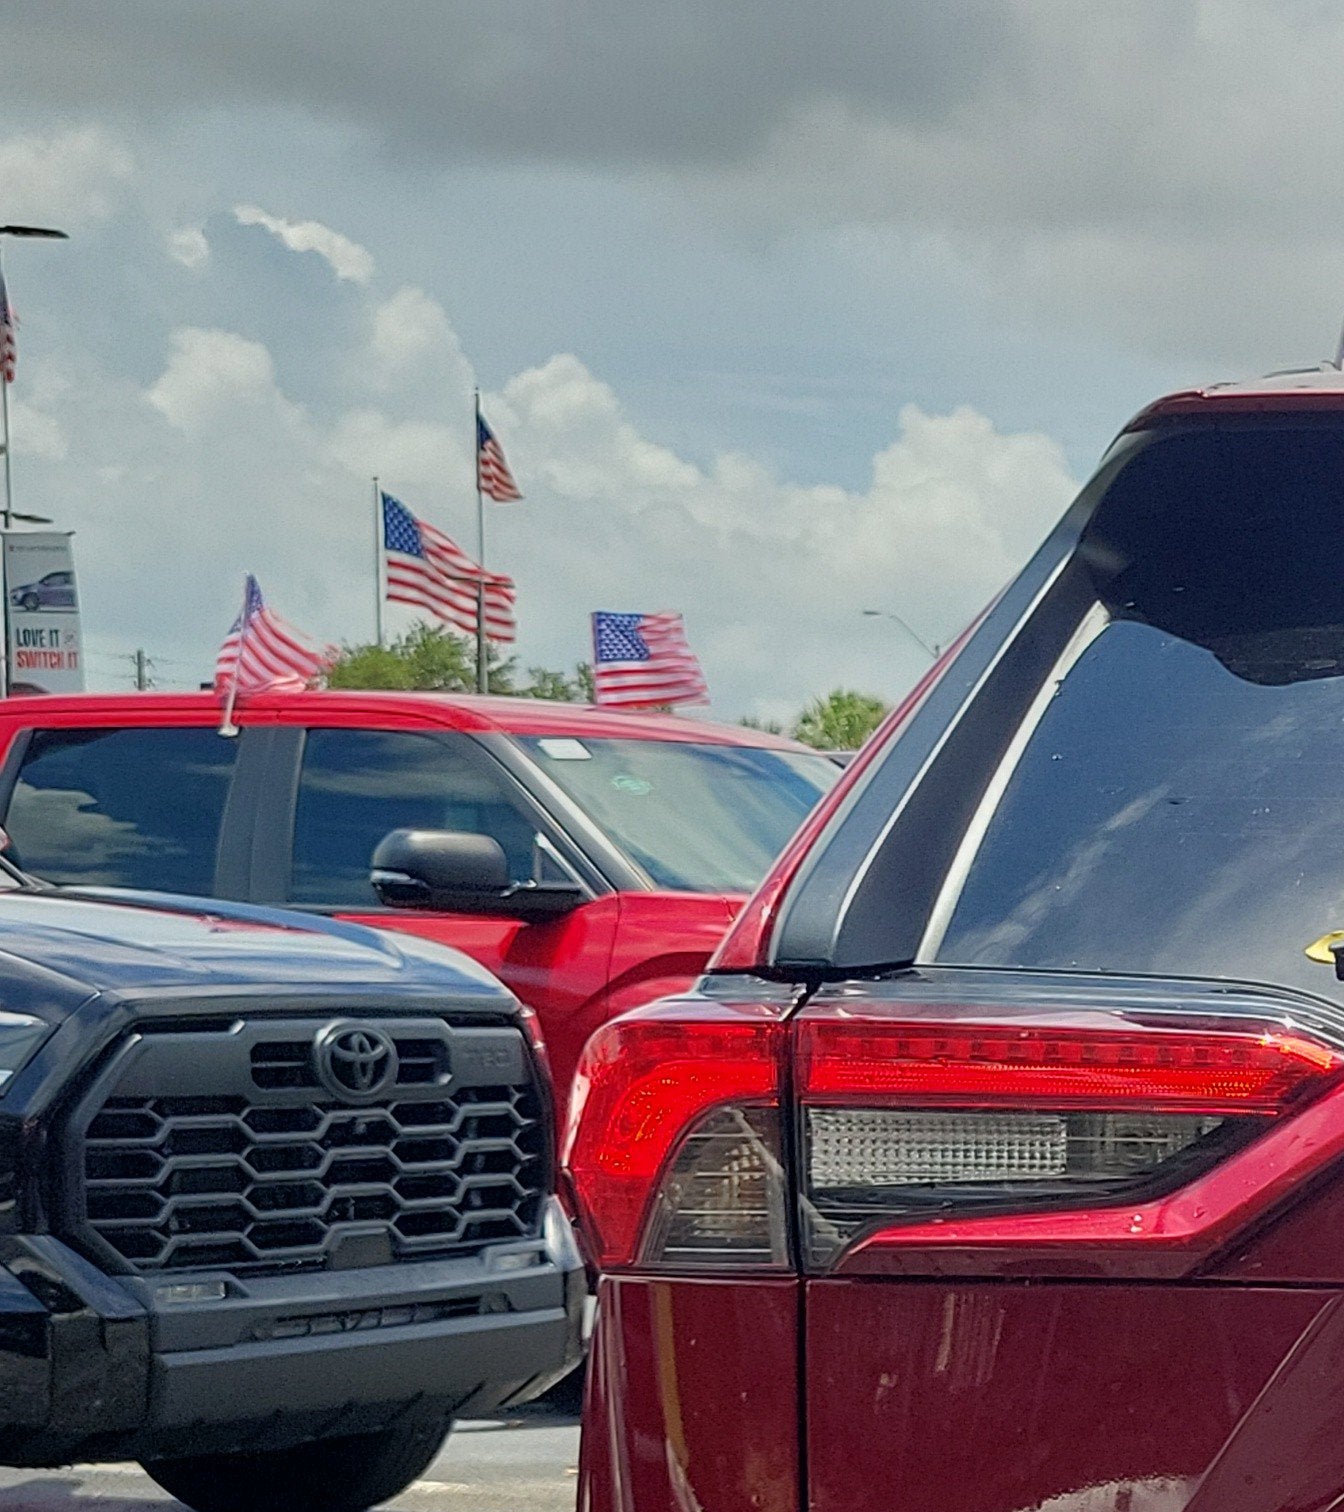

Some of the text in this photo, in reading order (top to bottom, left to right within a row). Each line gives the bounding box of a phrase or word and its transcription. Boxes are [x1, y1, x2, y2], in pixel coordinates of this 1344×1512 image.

[16, 628, 45, 647] LOVE
[49, 629, 59, 647] IT
[16, 651, 78, 669] SWITCH IT
